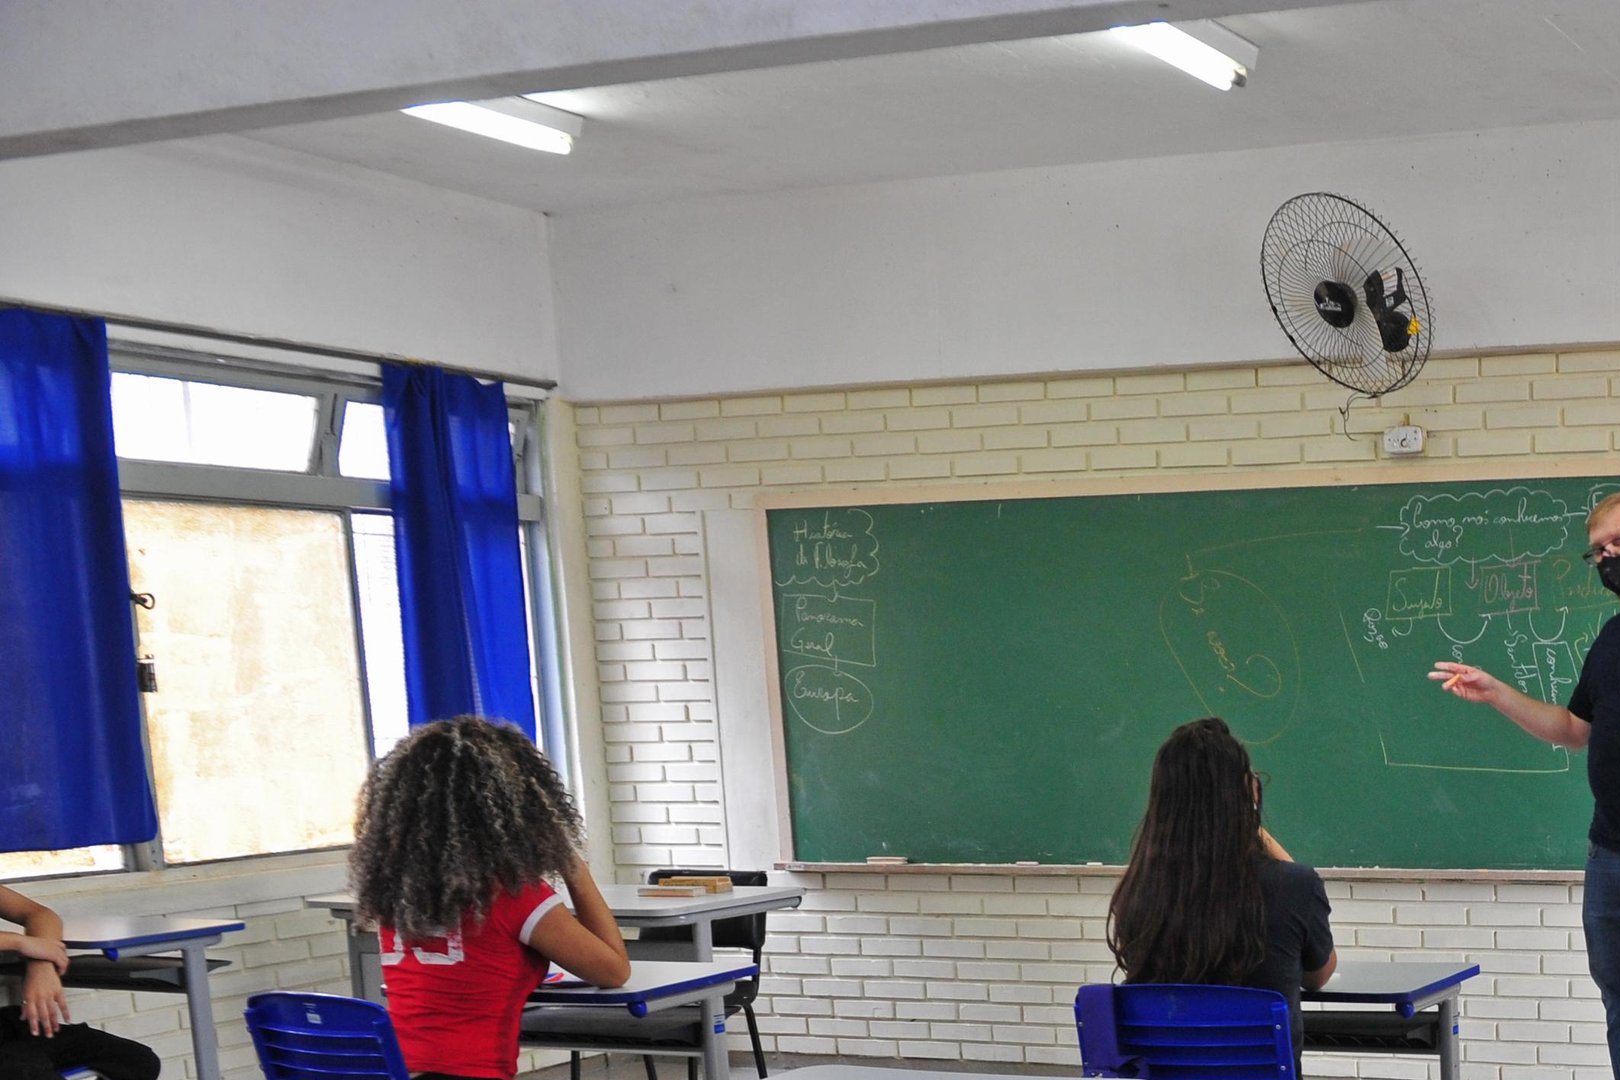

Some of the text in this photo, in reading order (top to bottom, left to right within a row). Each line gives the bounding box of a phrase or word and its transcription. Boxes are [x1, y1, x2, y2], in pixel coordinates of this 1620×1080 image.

[1413, 501, 1456, 529] Como
[1493, 497, 1563, 525] conhecemos
[1425, 525, 1463, 558] algo?
[1484, 562, 1534, 611] Objeto
[790, 627, 835, 657] Geral
[793, 670, 859, 721] Europa
